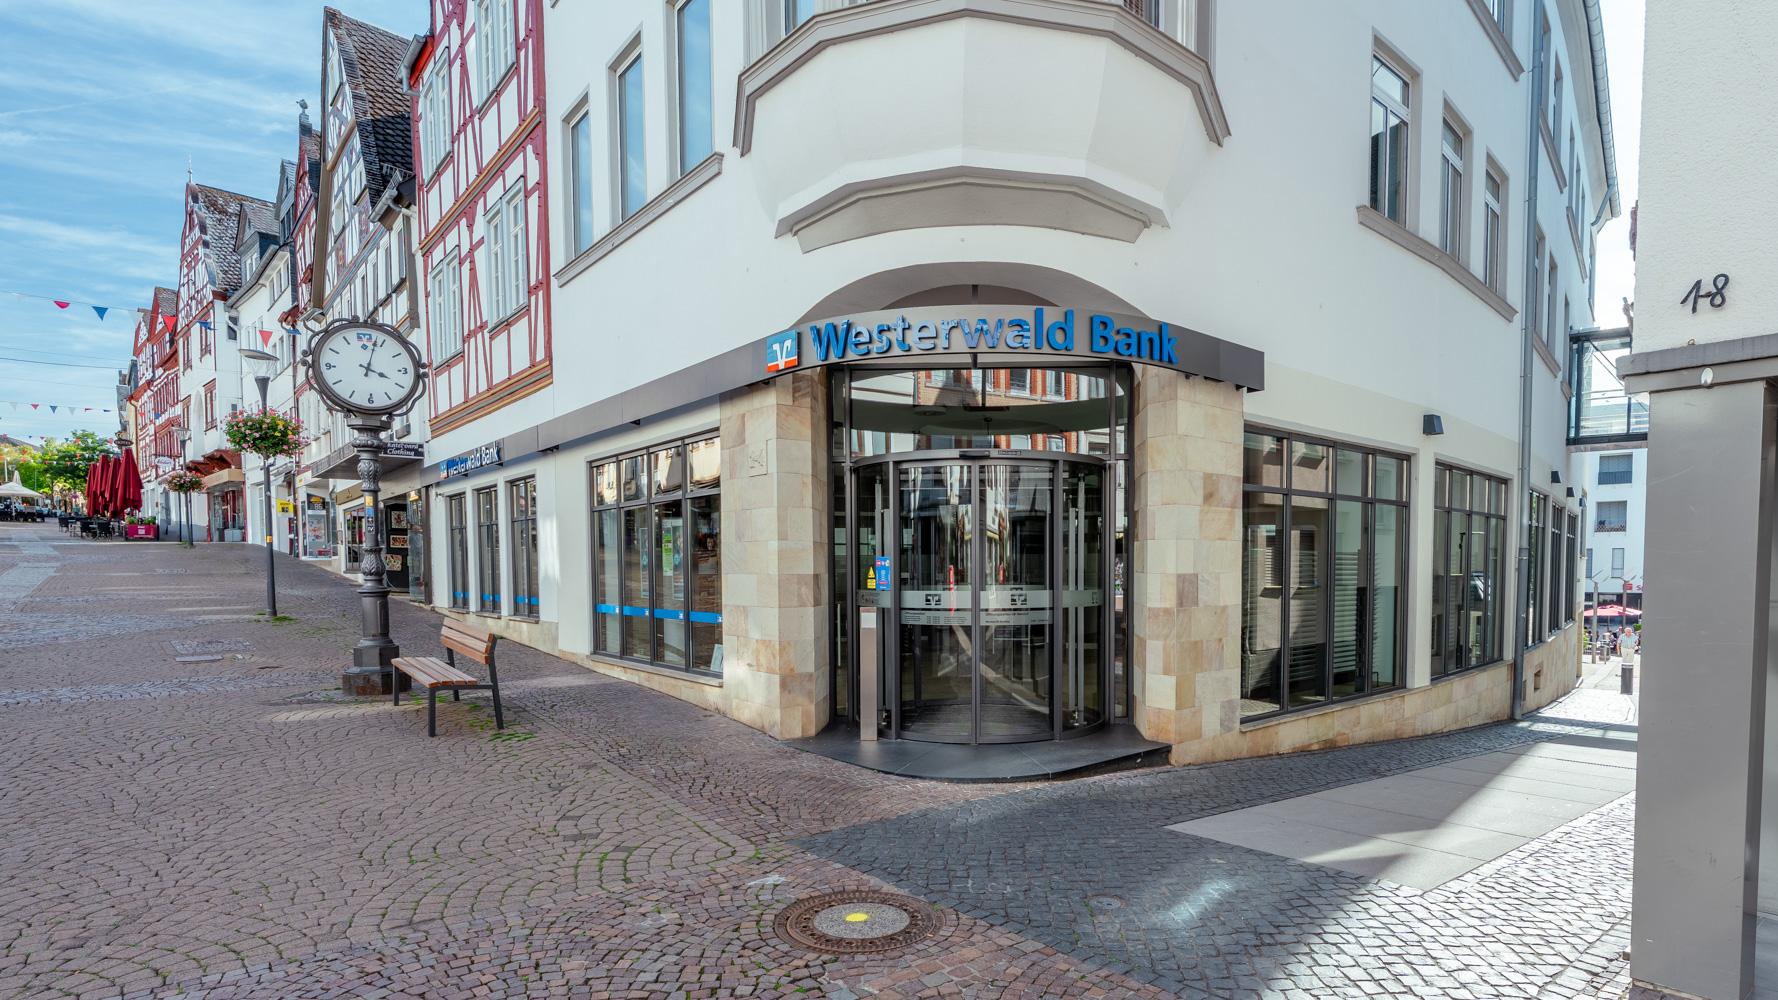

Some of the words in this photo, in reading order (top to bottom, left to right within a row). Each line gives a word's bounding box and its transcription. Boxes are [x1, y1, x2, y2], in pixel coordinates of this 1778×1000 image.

[810, 307, 1075, 361] Westerwald
[1090, 314, 1179, 364] Bank
[482, 440, 500, 466] Bank
